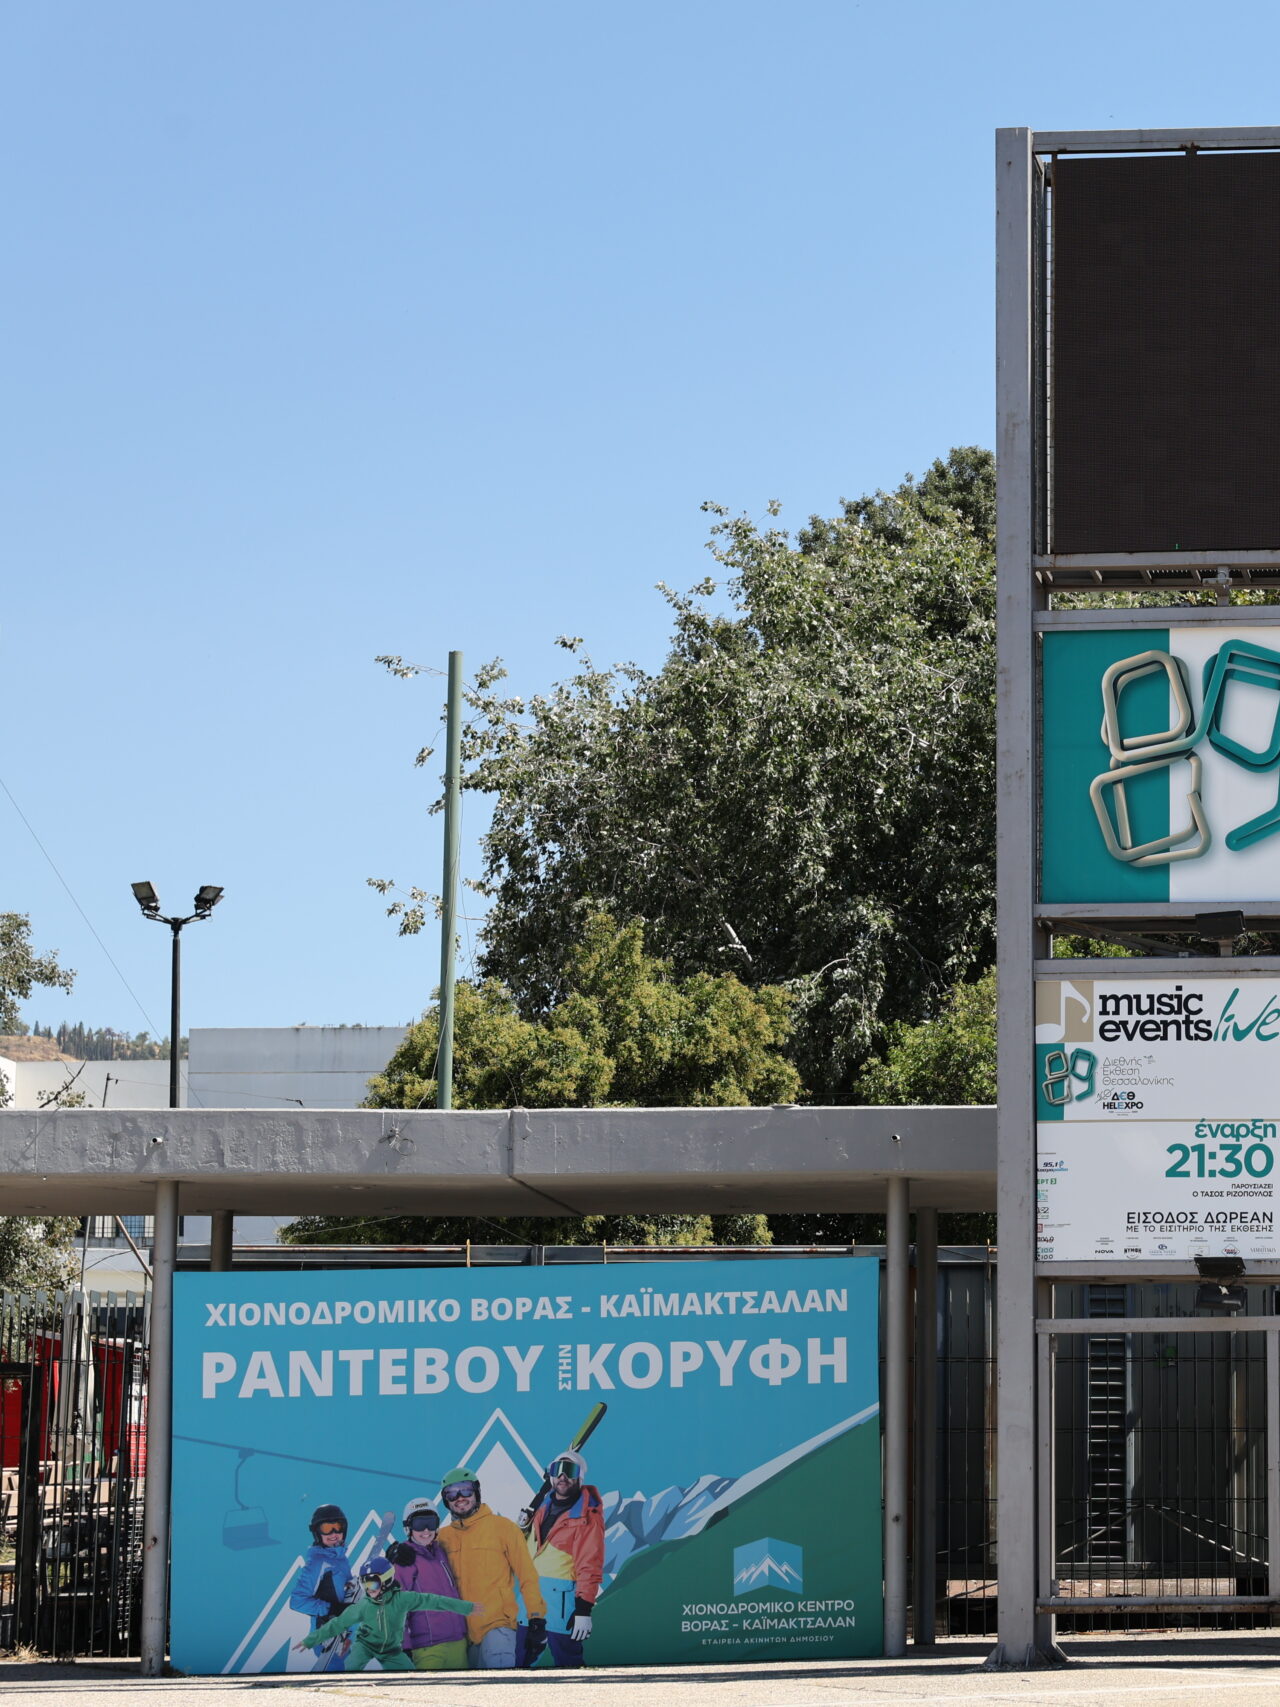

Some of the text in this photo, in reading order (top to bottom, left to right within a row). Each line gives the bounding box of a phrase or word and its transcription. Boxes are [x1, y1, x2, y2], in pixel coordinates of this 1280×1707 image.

[1099, 985, 1203, 1016] music
[1099, 1013, 1213, 1042] events
[1102, 1056, 1143, 1067] Διεθνής
[1102, 1075, 1175, 1086] Θεσσαλονίκης
[1102, 1101, 1144, 1110] HELEXPO
[1194, 1118, 1277, 1142] έναρξη
[1165, 1143, 1275, 1179] 21:30
[1126, 1211, 1273, 1224] ΕΙΣΟΔΟΣ ΔΩΡΕΑΝ
[1230, 1224, 1274, 1232] ΕΚΘΕΣΗΣ
[204, 1299, 461, 1327] ΧΙΟΝΟΔΡΟΜΙΚΟ
[471, 1297, 573, 1322] ΒΟΡΑΣ
[600, 1287, 847, 1318] ΚΑΪΜΑΚΤΣΑΛΑΝ
[202, 1337, 847, 1398] ΡΑΝΤΕΒΟΥ ΣΤΗΝ ΚΟΡΥΦΗ
[682, 1600, 855, 1616] ΧΙΟΝΟΔΡΟΜΙΚΟ ΚΕΝΤΡΟ
[681, 1620, 729, 1632] ΒΟΡΑΣ
[743, 1616, 855, 1630] ΚΑΪΜΑΚΤΣΑΛΑΝ
[789, 1635, 834, 1643] ΔΗΜΟΣΙΟΥ
